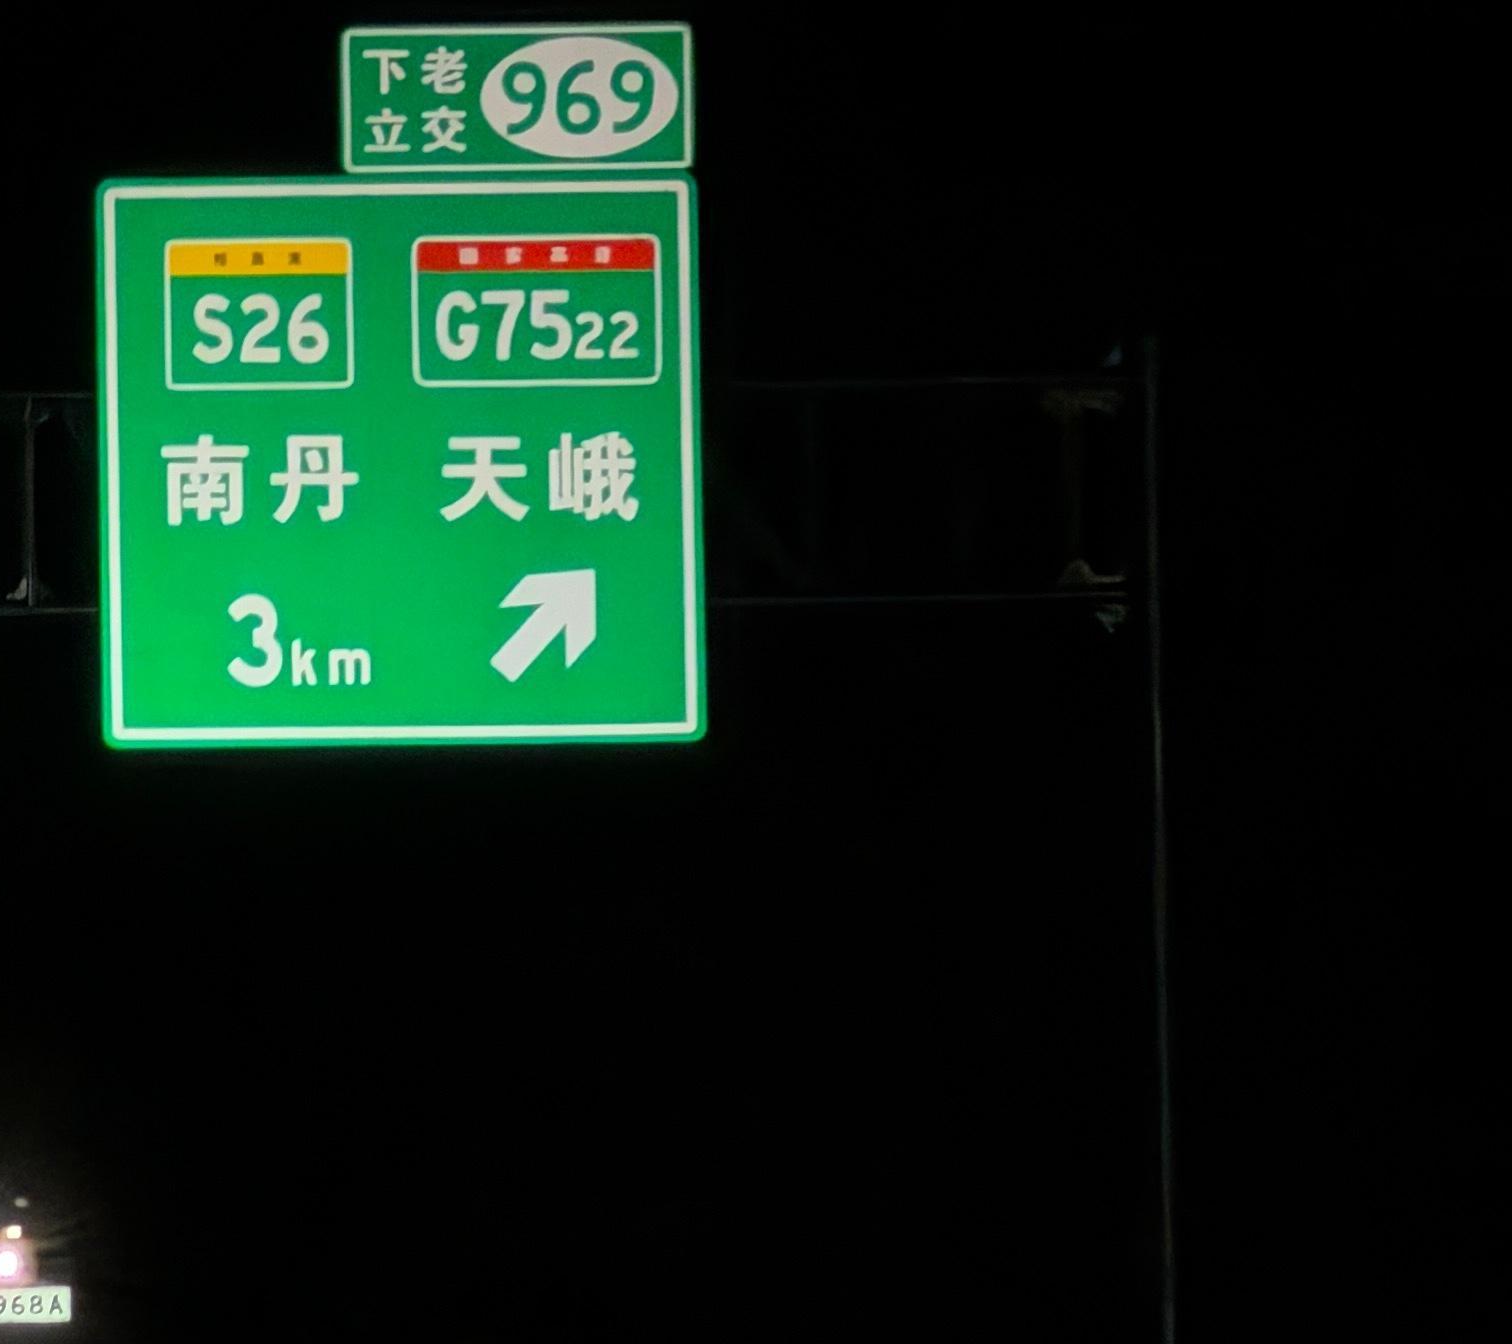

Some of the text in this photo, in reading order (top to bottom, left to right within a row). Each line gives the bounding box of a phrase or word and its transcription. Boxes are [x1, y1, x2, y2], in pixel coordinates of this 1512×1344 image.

[364, 47, 466, 93] 下老
[501, 59, 656, 136] 969
[365, 107, 465, 152] 立交
[194, 294, 328, 363] S26
[436, 290, 637, 360] G7522
[161, 432, 638, 525] 南丹 天峨
